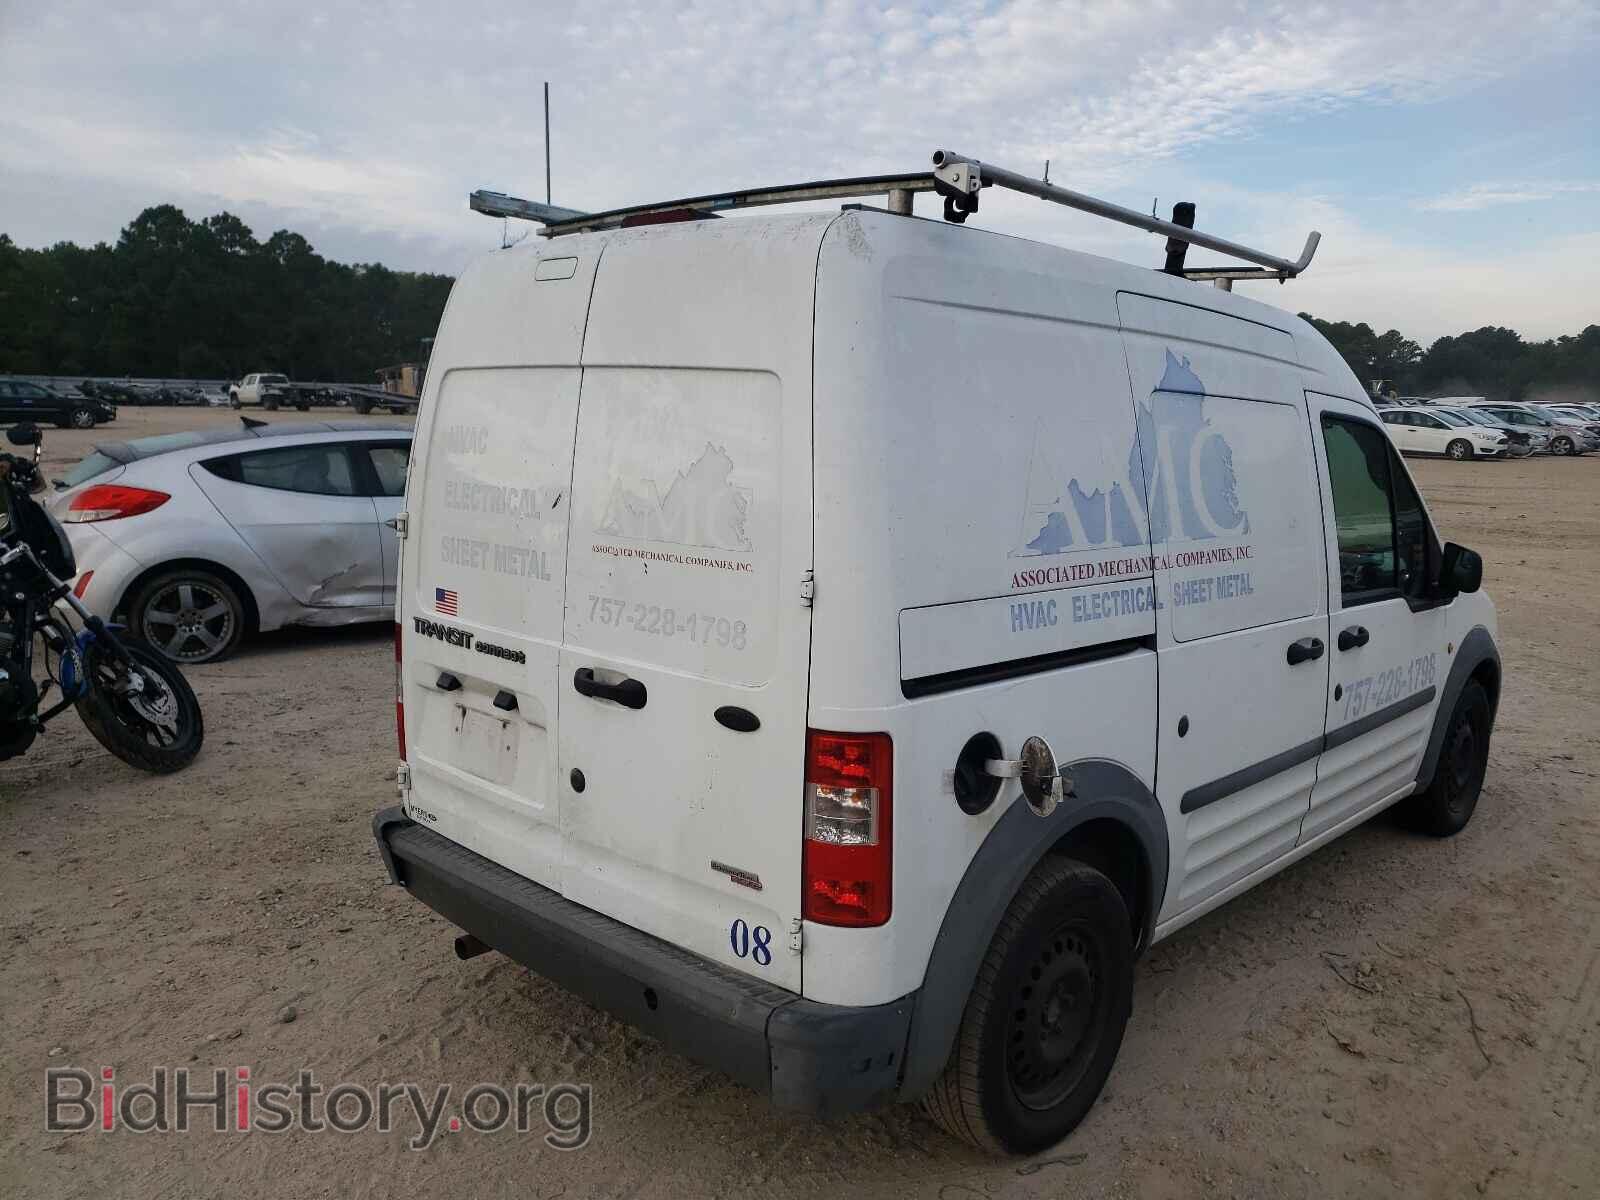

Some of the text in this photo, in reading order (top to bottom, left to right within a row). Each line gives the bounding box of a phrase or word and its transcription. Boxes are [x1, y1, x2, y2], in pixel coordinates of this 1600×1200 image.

[441, 536, 552, 581] SHEET METAL
[592, 544, 632, 557] ASSOCIATED
[634, 550, 684, 564] MECHANICAL
[1011, 565, 1094, 588] ASSOCIATED
[1098, 555, 1173, 577] MECHANICAL
[1175, 547, 1234, 567] COMPANIES,
[588, 594, 747, 650] 757-228-1798
[1010, 572, 1254, 632] HVAC ELECTRICAL SHEET METAL
[413, 616, 526, 664] TRANSIT connect
[731, 919, 772, 966] 08
